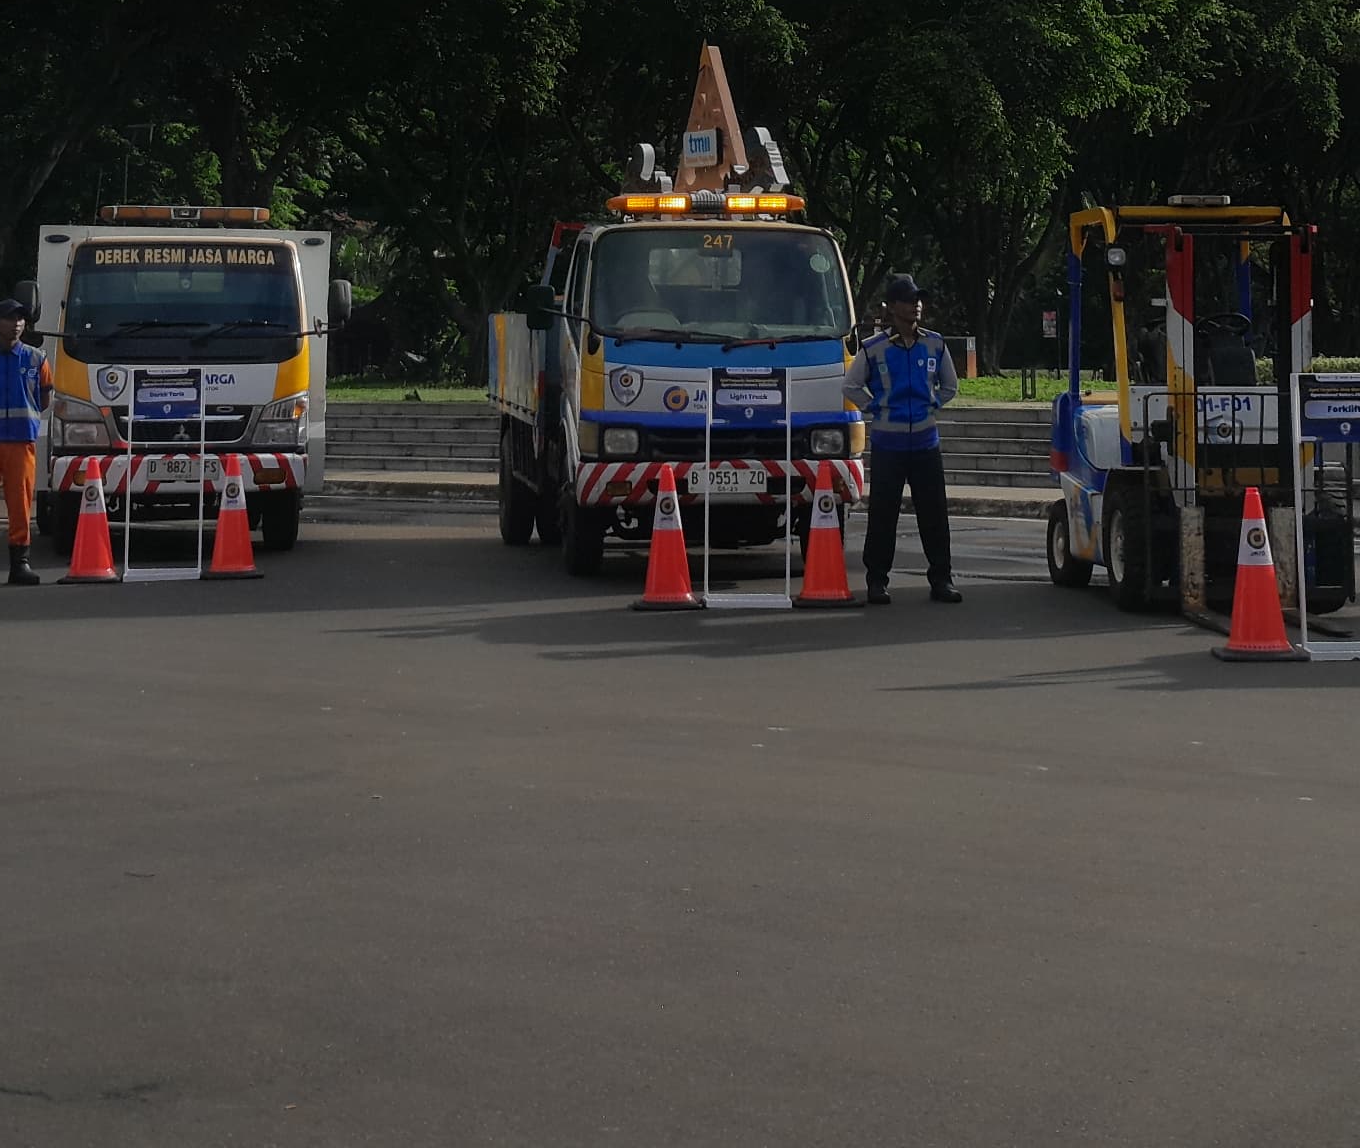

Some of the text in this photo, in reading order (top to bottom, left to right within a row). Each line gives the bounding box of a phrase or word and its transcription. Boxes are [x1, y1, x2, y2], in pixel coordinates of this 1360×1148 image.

[704, 234, 733, 249] 247
[95, 248, 275, 265] DEREK RESMI JASA MARGA
[150, 460, 157, 472] D
[691, 472, 699, 484] B
